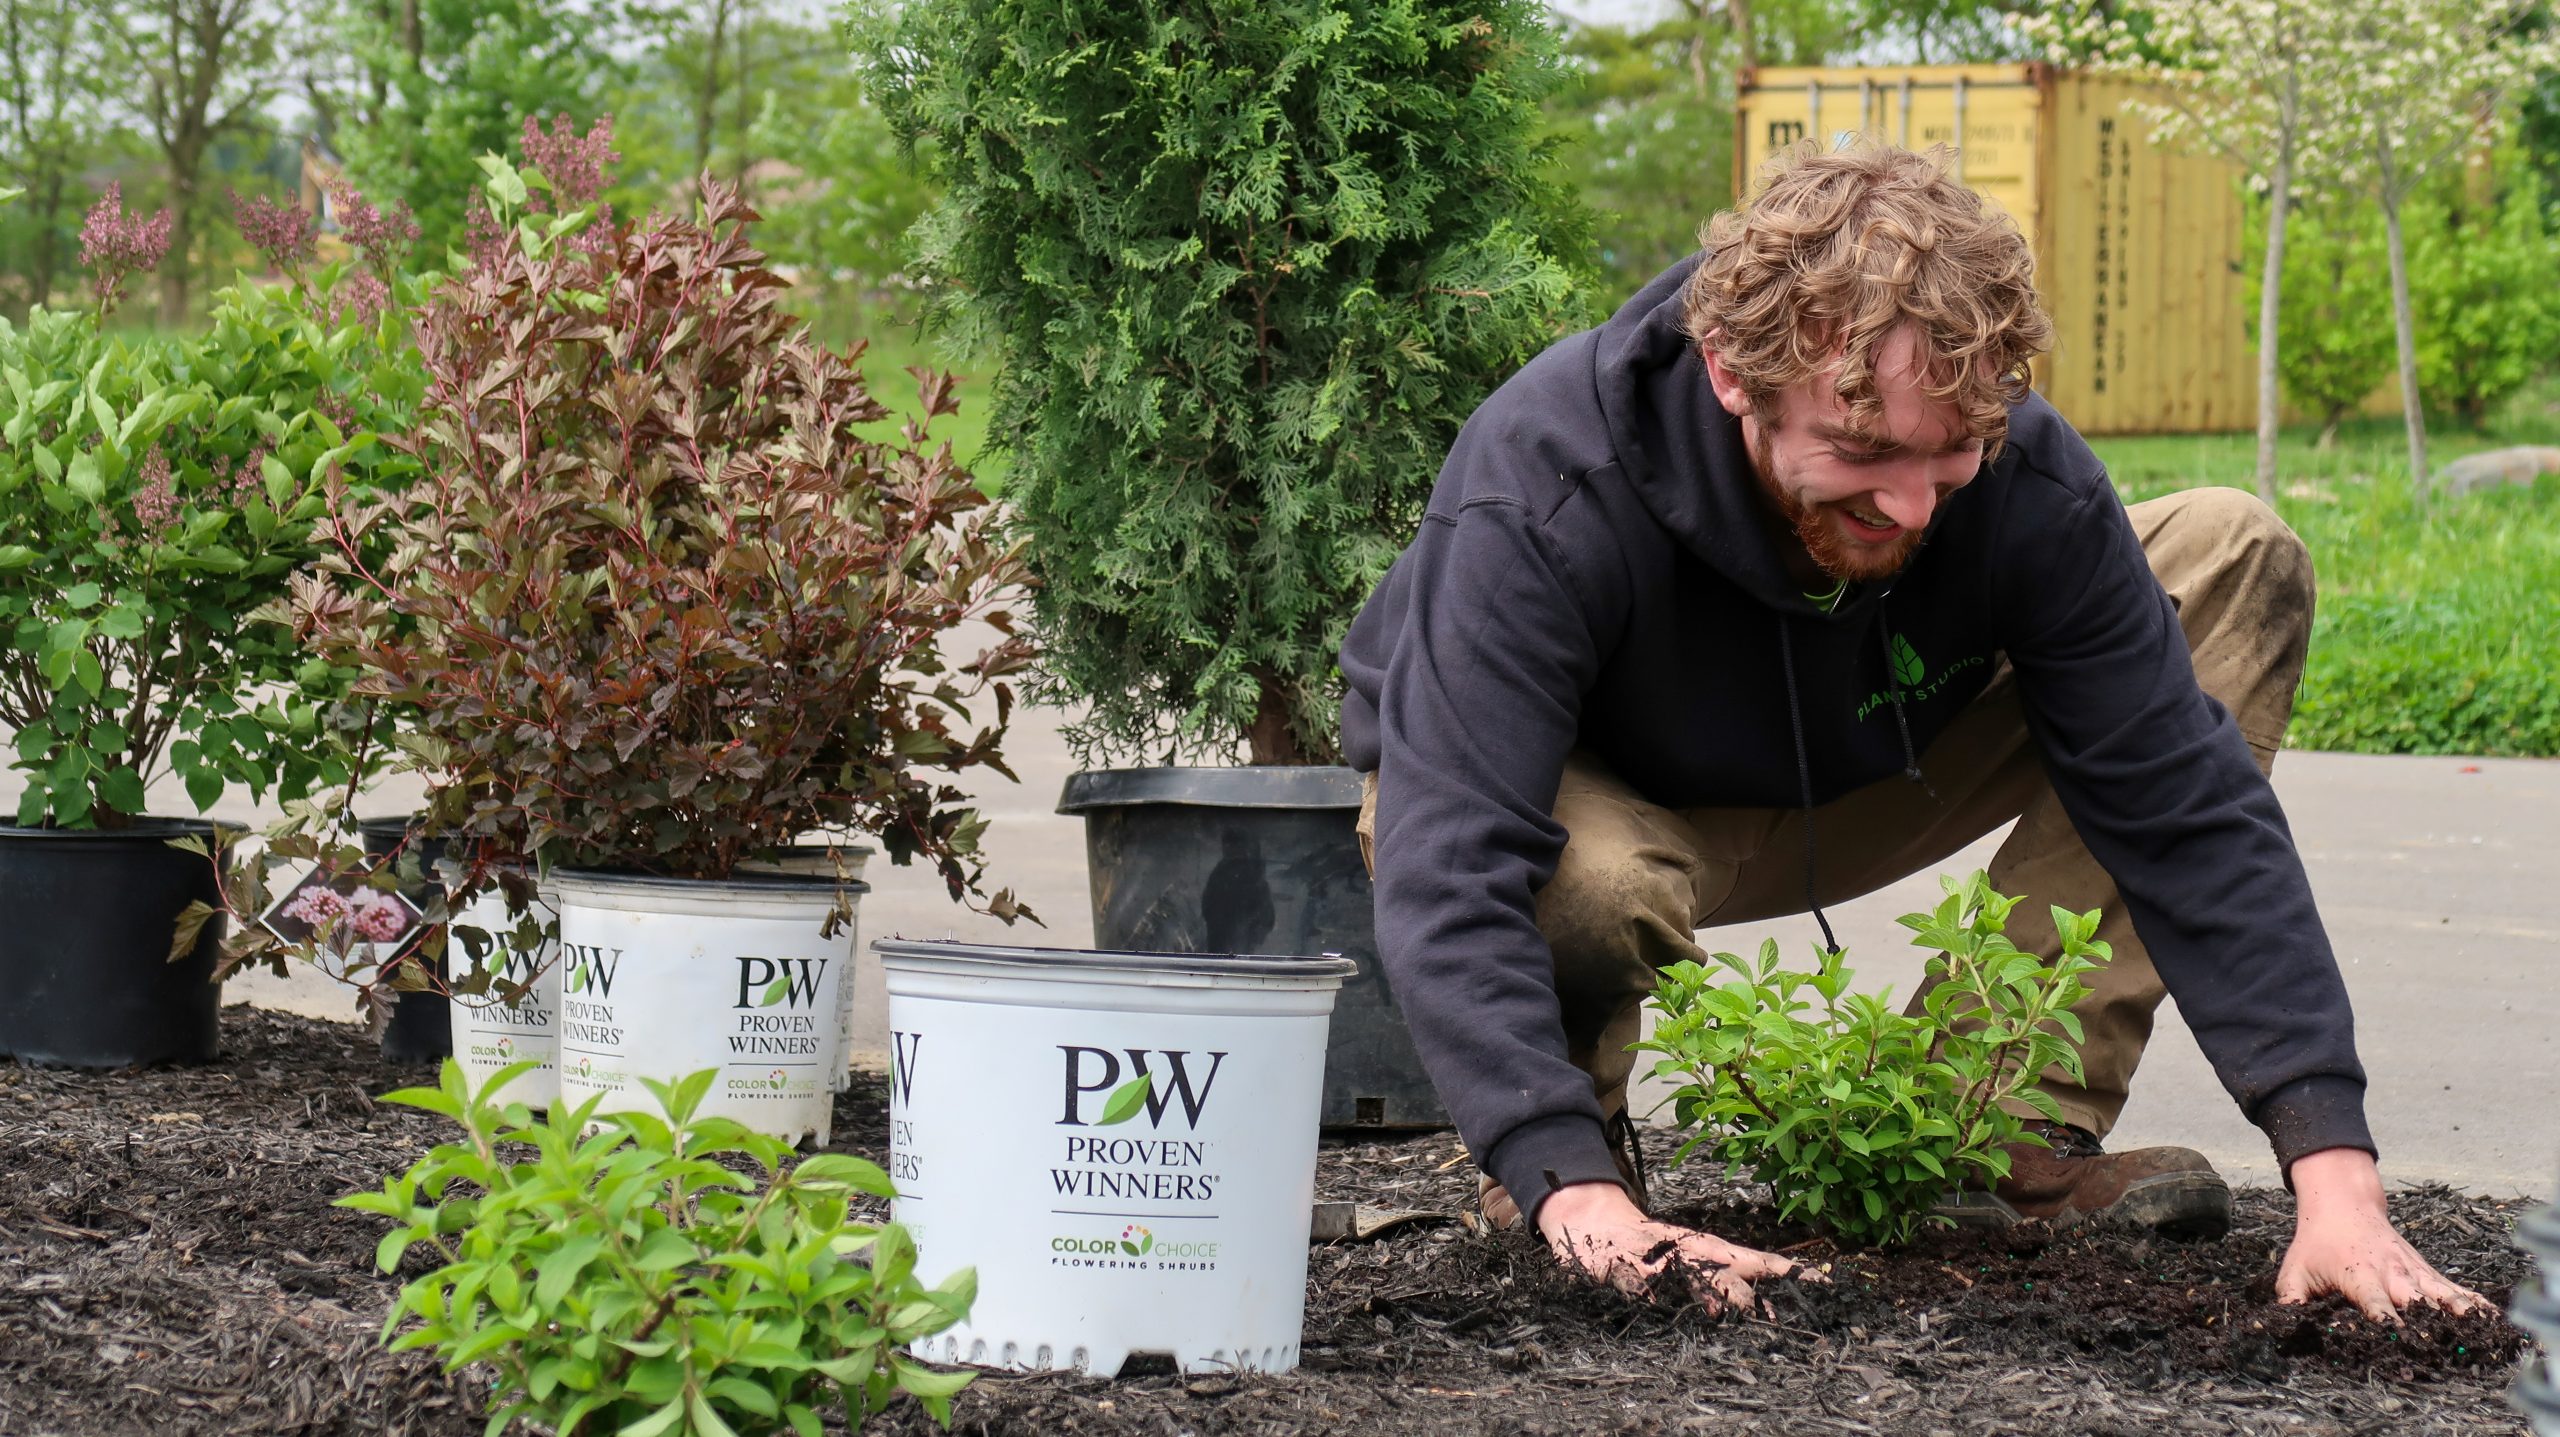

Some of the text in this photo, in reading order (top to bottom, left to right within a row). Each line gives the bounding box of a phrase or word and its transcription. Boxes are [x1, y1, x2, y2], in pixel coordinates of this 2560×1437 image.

[1915, 656, 1985, 702] STUDIO
[563, 942, 624, 999] PW
[732, 956, 828, 1010] PW
[565, 1000, 614, 1024] PROVEN
[740, 1015, 815, 1033] PROVEN
[471, 1045, 497, 1057] COLOR
[591, 1071, 625, 1083] CHOICE
[728, 1079, 767, 1090] COLOR
[1054, 1045, 1229, 1131] PW
[1066, 1136, 1205, 1167] PROVEN
[1051, 1237, 1217, 1258] COLOR CHOICE
[1052, 1257, 1216, 1271] FLOWERING SHRUBS
